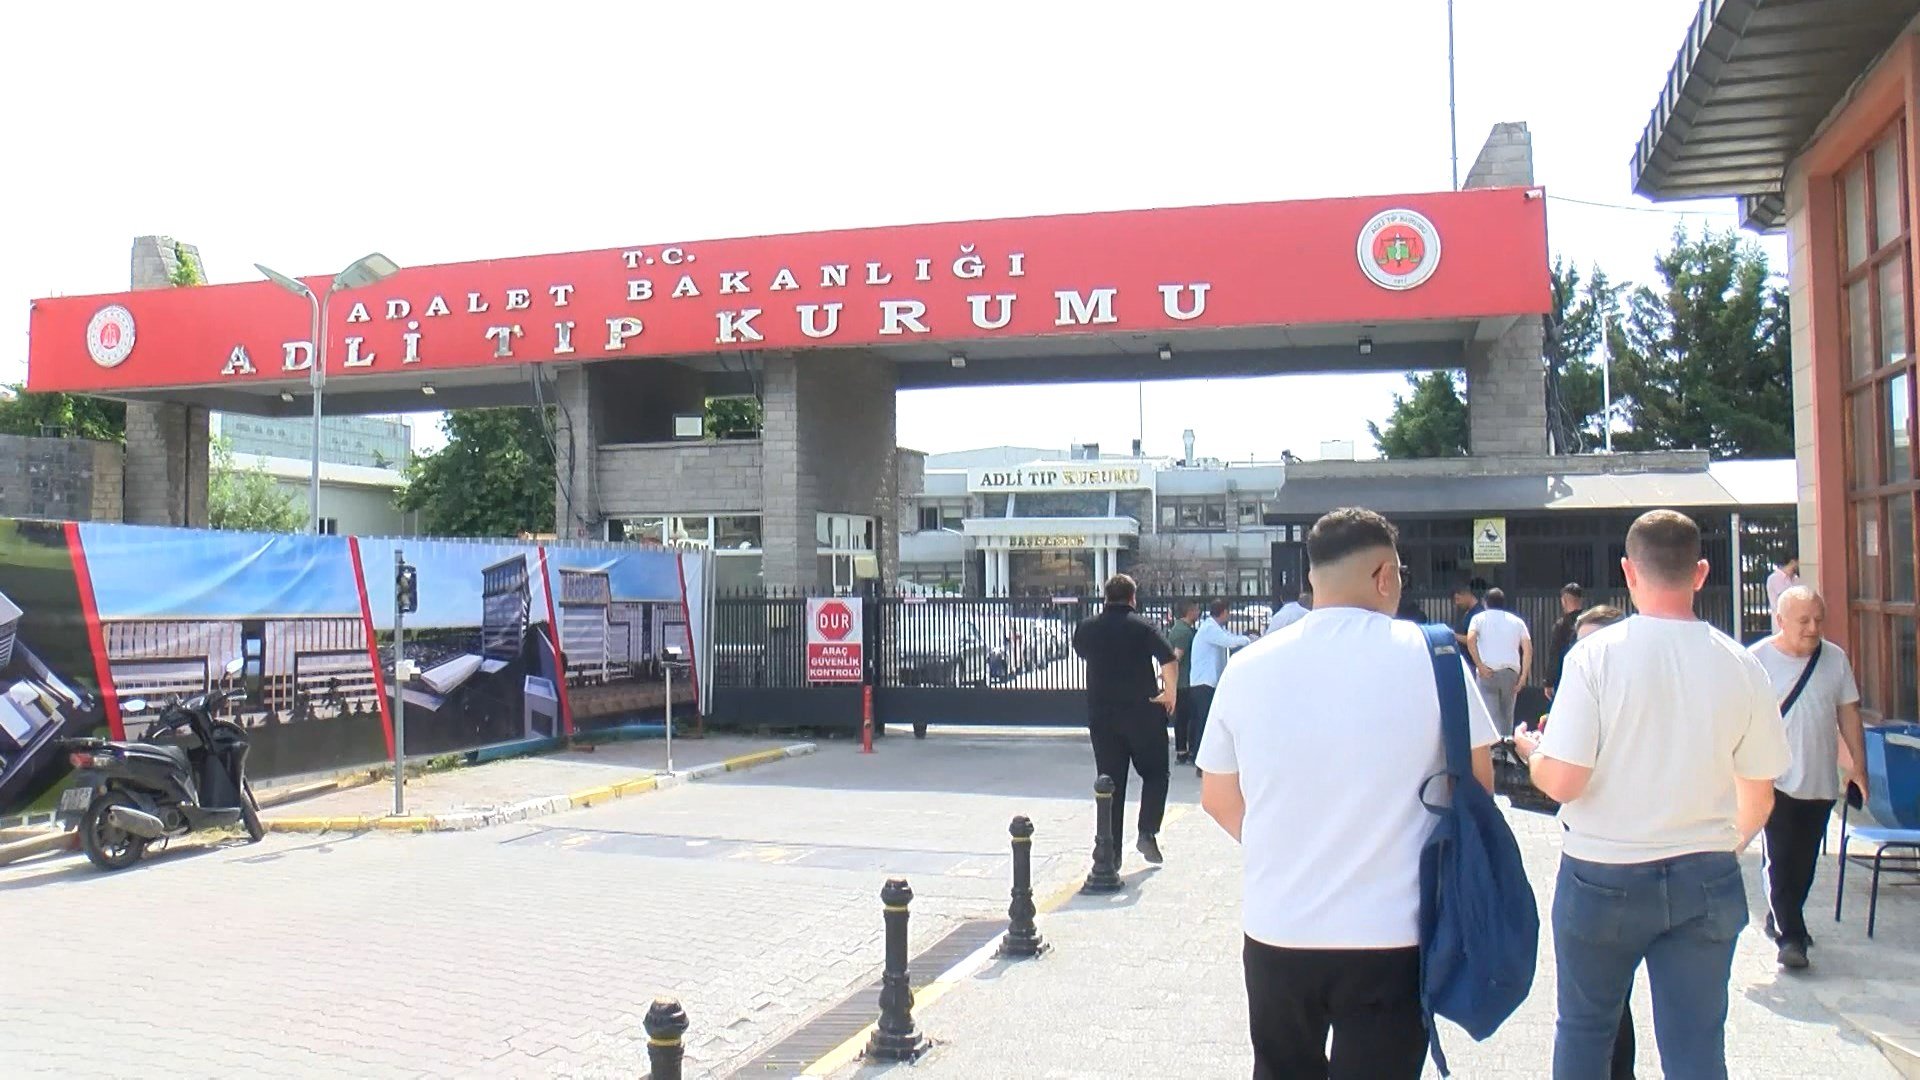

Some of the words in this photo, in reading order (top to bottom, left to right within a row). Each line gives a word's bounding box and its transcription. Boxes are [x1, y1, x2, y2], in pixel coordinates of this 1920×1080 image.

[622, 248, 696, 269] T.C.
[346, 284, 575, 323] ADALET
[626, 243, 1026, 302] BAKANLIĞI
[220, 320, 421, 376] ADLİ
[486, 316, 645, 360] TIP
[715, 282, 1211, 345] KURUMU
[980, 469, 1023, 487] ADLİ
[1028, 471, 1058, 486] TIP
[819, 613, 850, 630] DUR
[822, 646, 849, 657] ARAÇ
